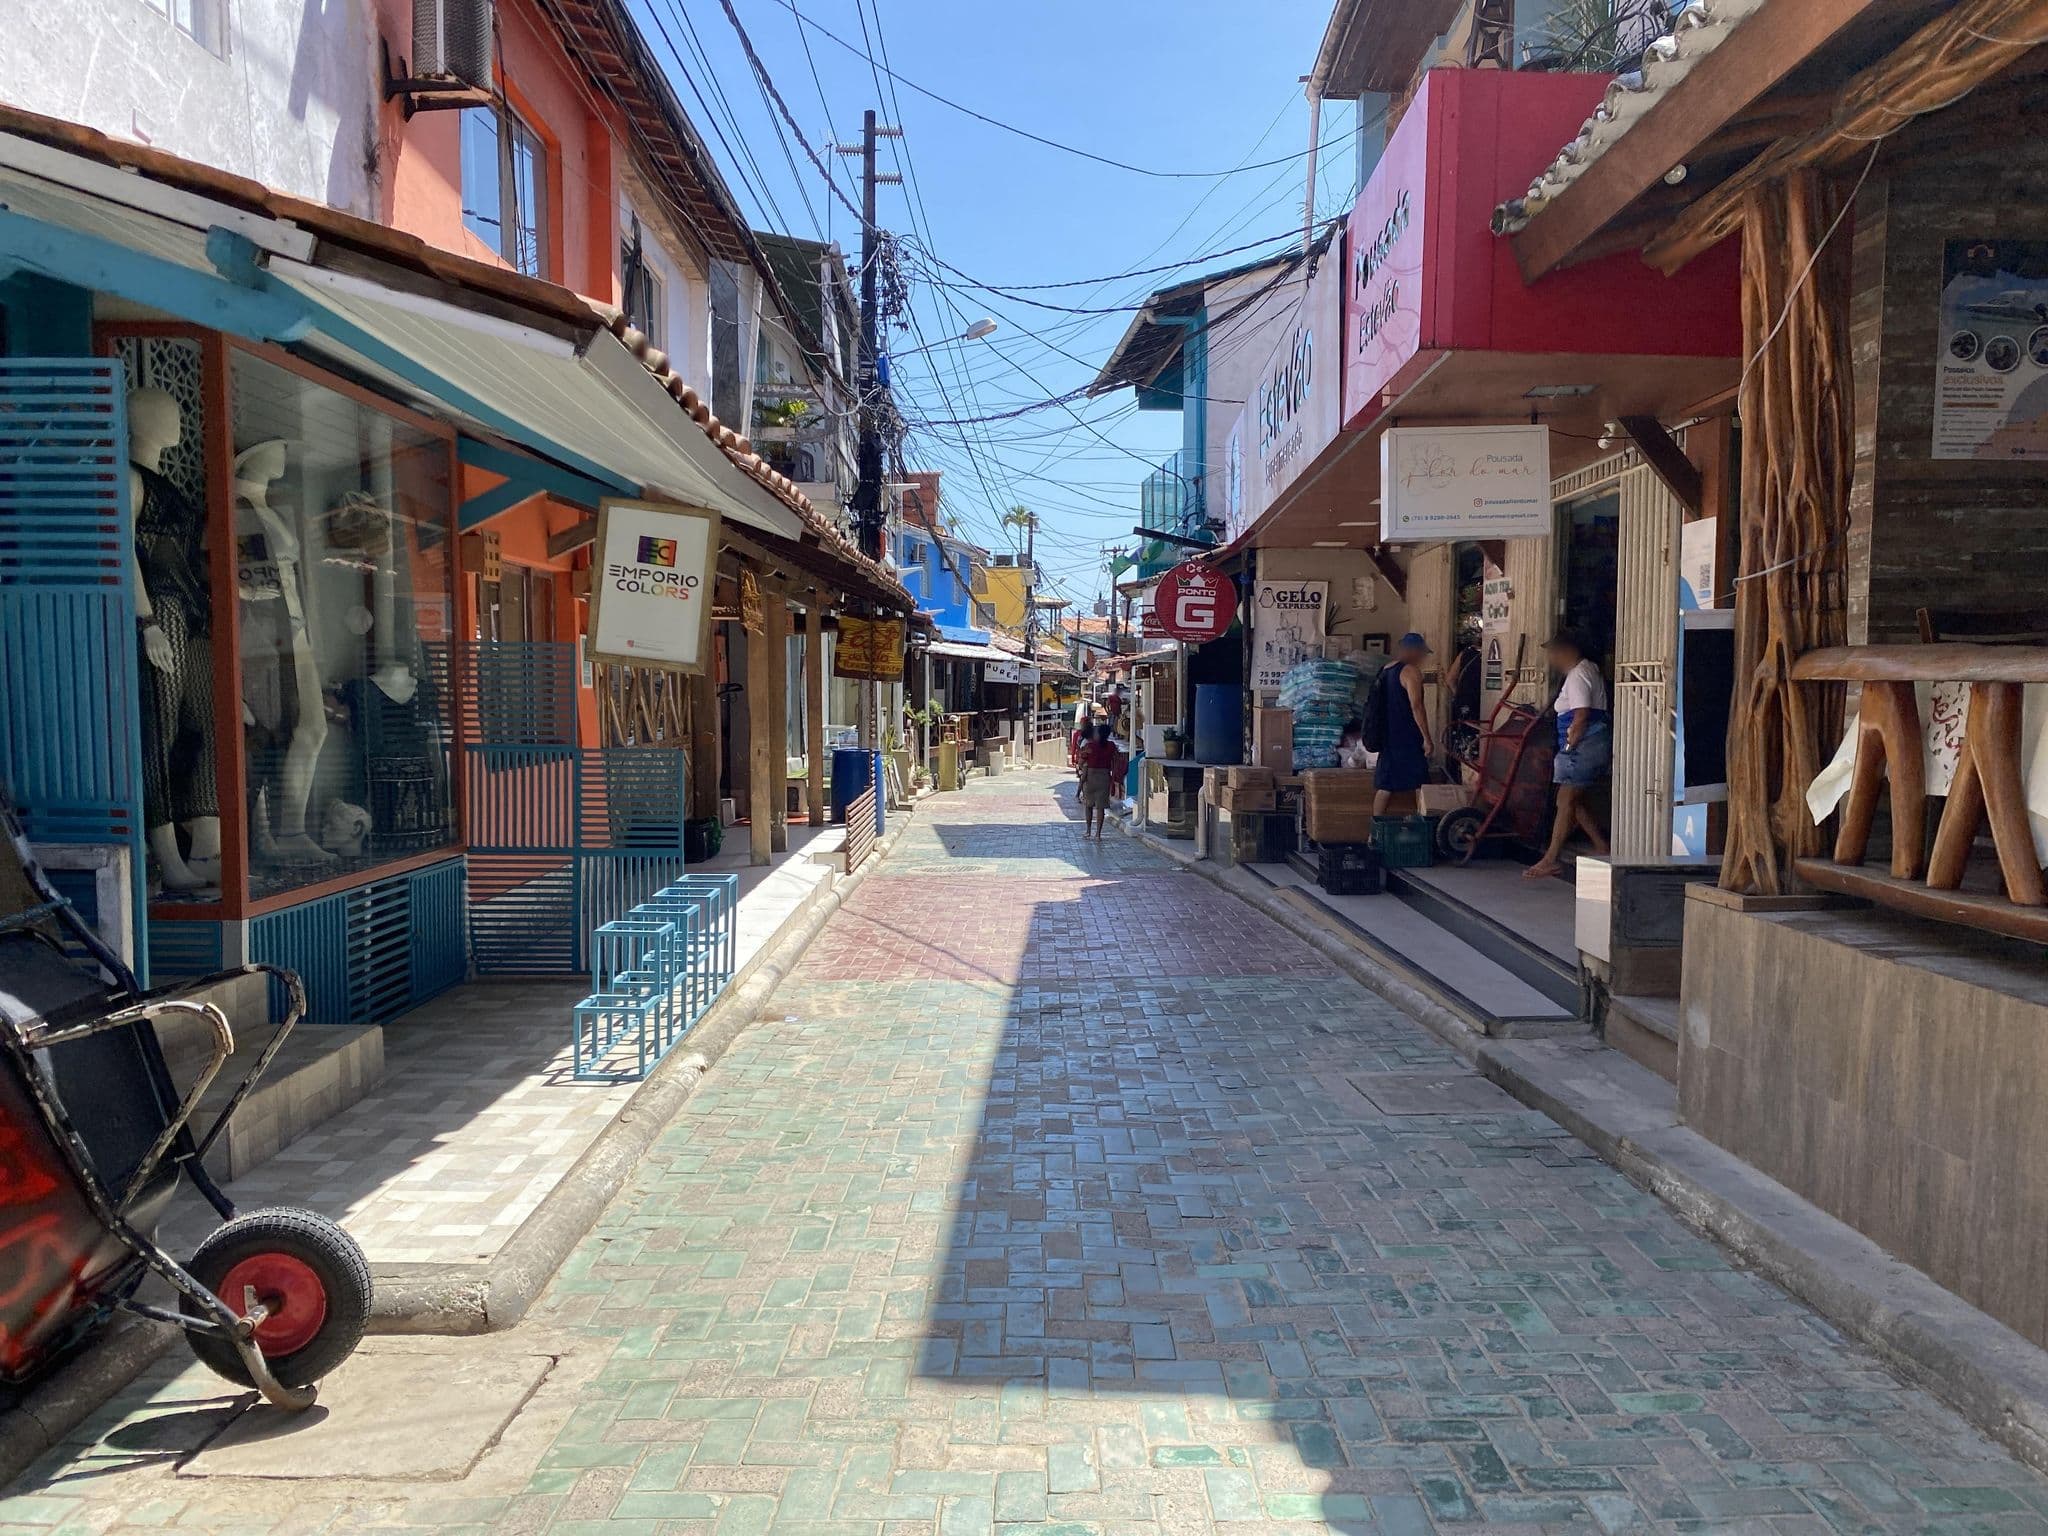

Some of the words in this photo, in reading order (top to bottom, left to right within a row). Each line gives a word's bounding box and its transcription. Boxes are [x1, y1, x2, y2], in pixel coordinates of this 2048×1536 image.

[1355, 188, 1410, 301] Pousada
[1359, 277, 1399, 354] Estevão
[1259, 322, 1313, 459] Estevão
[1486, 454, 1523, 463] Pousada
[608, 564, 699, 588] EMPORIO
[616, 579, 689, 600] COLORS
[1177, 588, 1217, 597] PONTO
[1276, 590, 1322, 603] GELO
[1175, 595, 1216, 629] G
[1277, 602, 1321, 610] EXPRESSO
[986, 663, 1018, 681] AUREA
